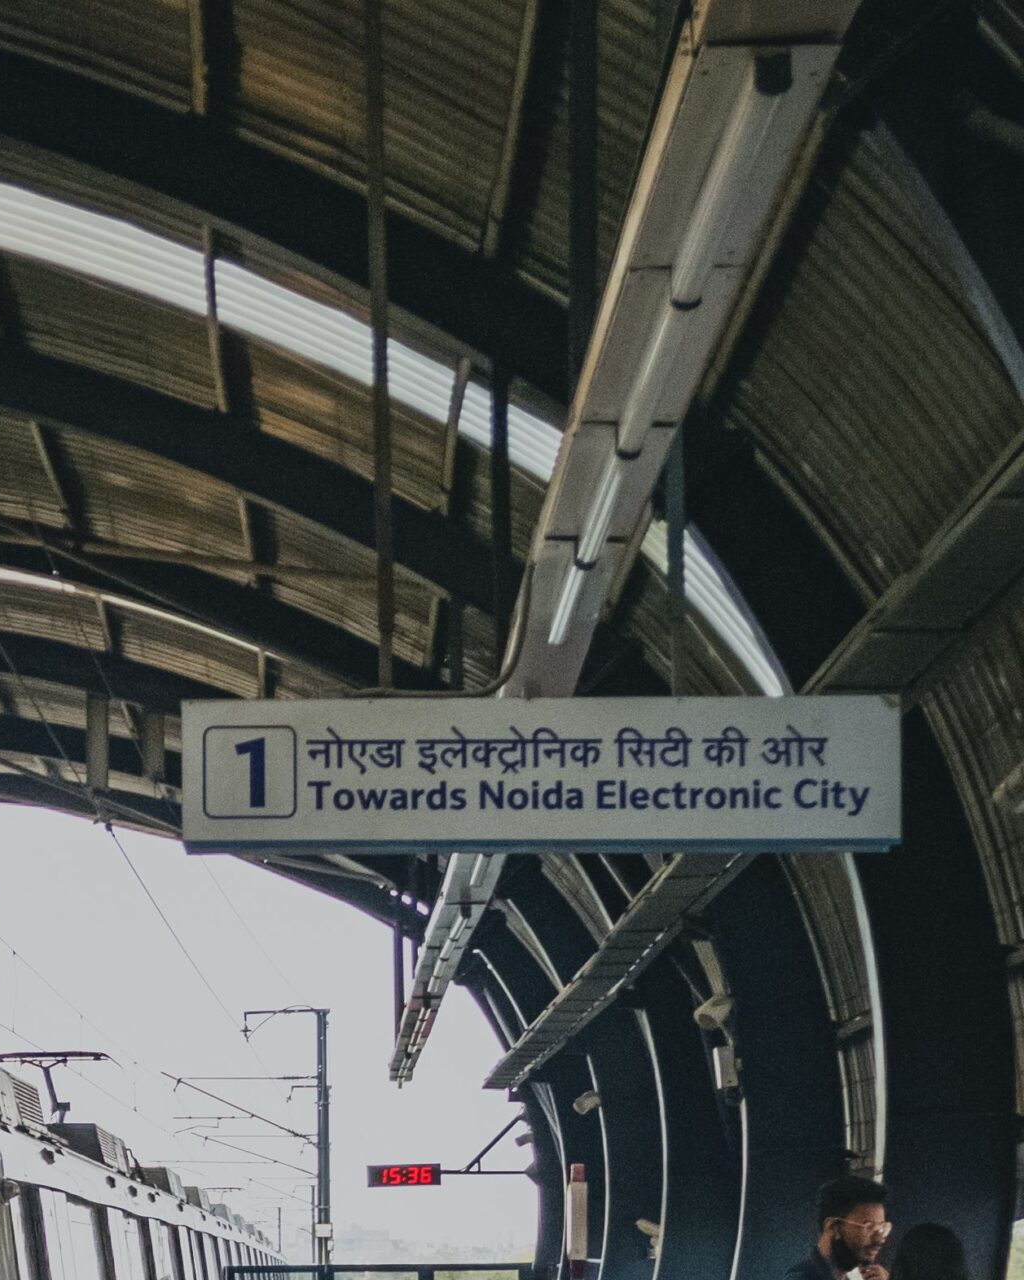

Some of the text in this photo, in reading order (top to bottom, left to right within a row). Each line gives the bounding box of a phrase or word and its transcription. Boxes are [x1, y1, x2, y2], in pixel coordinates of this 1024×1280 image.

[306, 726, 405, 774] नोएडा
[614, 727, 692, 768] सिटी
[702, 726, 749, 768] की
[761, 724, 828, 767] ओर
[235, 737, 265, 808] 1
[307, 778, 870, 816] Towards Noida Electronic City
[382, 1166, 432, 1185] 15:36
